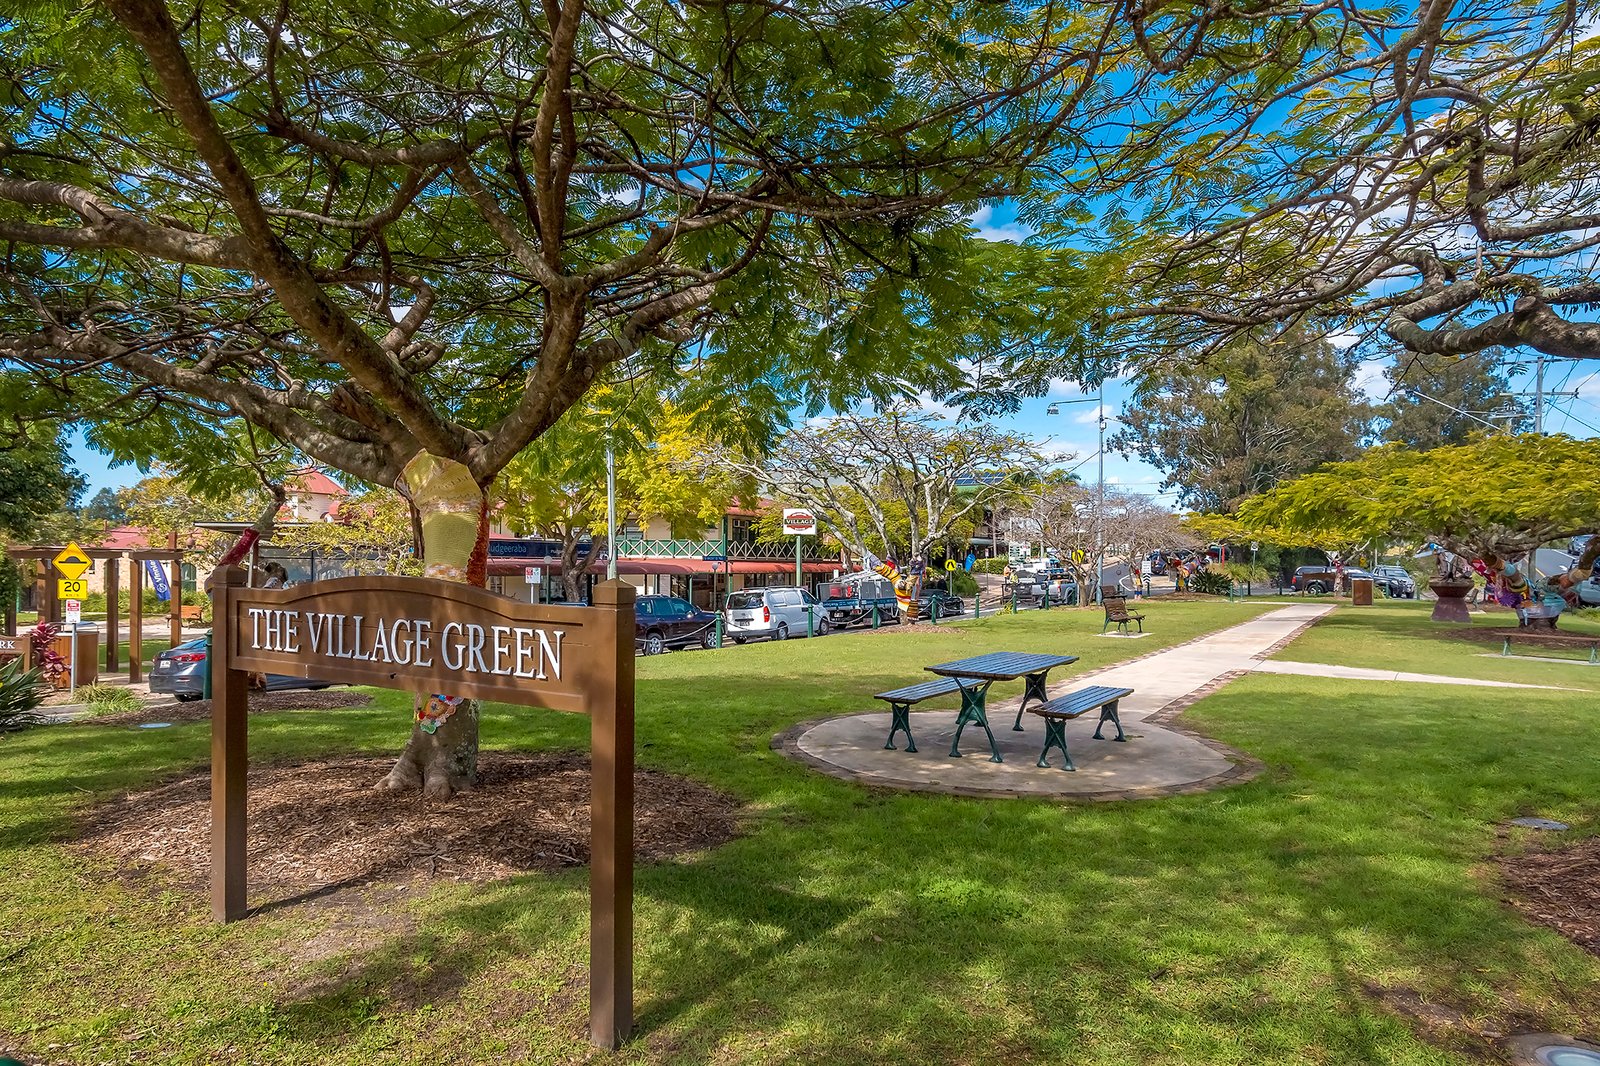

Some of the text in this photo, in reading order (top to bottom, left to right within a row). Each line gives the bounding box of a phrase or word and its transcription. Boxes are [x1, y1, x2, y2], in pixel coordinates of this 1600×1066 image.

[489, 543, 527, 555] udgeeraba
[64, 581, 81, 592] 20
[248, 608, 565, 680] THE VILLAGE GREEN
